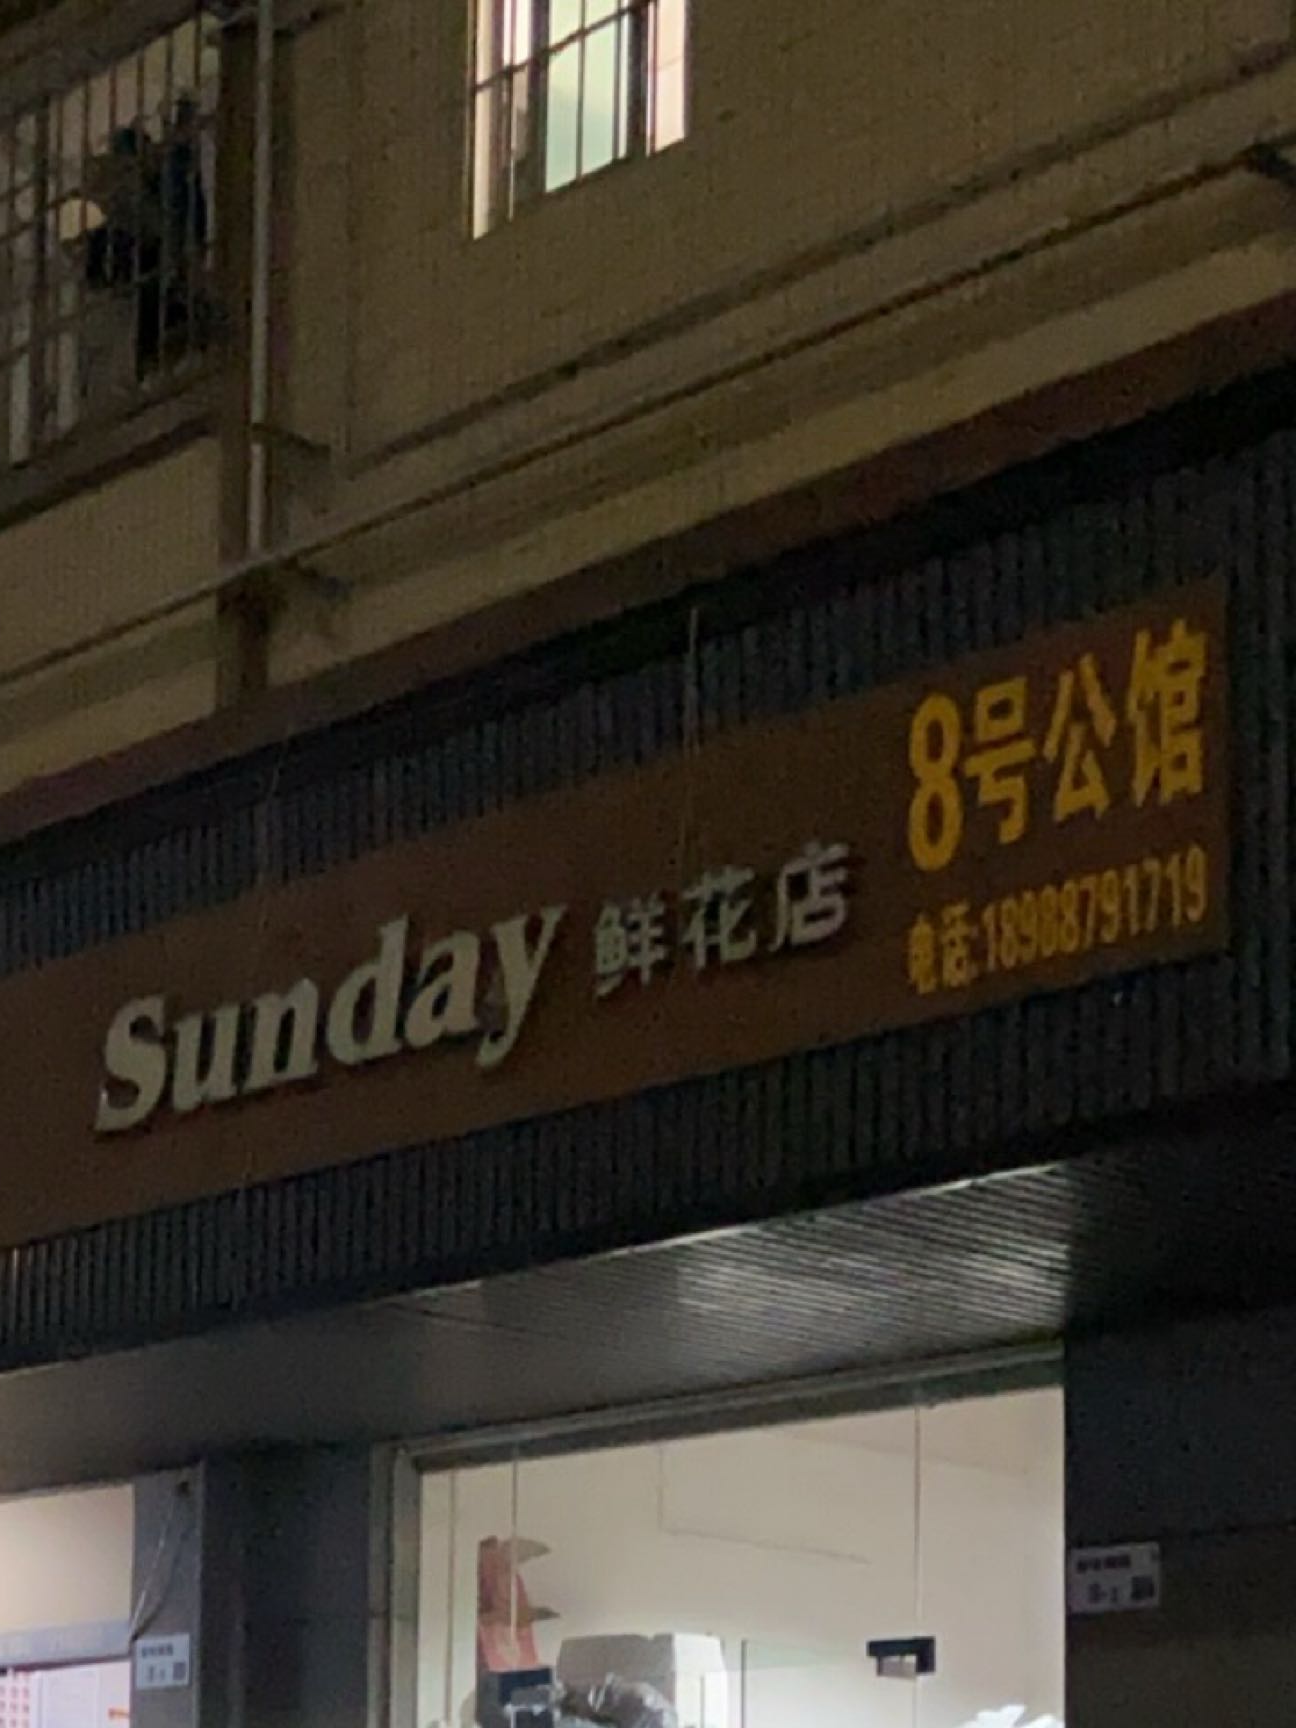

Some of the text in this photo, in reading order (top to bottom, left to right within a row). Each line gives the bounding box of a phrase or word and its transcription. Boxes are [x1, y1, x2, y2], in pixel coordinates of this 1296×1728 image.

[908, 618, 1208, 873] 8号公馆
[94, 904, 567, 1133] Sunday
[594, 845, 850, 997] 鲜花店
